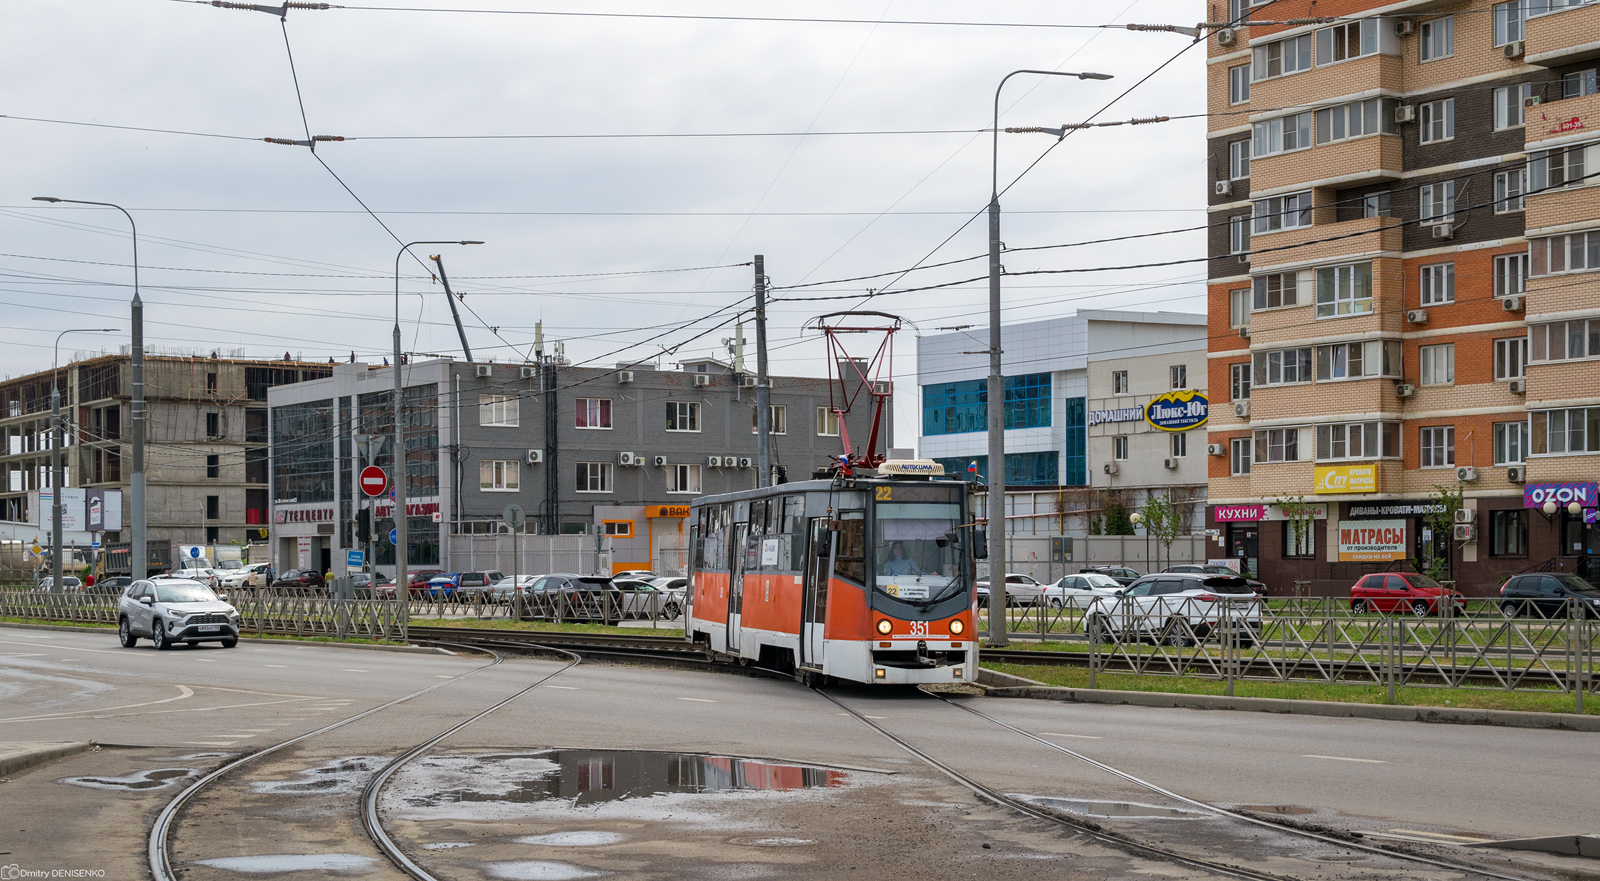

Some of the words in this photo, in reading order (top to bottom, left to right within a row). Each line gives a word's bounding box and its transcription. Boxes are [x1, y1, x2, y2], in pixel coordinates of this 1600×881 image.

[1088, 405, 1144, 426] ДОМАШНИЙ
[1151, 401, 1207, 420] Люкс-Юг
[1350, 468, 1371, 476] КРОВАТИ
[1350, 477, 1373, 485] МАТРАСЫ
[875, 486, 892, 501] 22
[1532, 487, 1587, 503] OZON
[289, 509, 334, 522] ТЕХЦЕНТР
[1218, 508, 1258, 519] КУХНИ
[1341, 528, 1404, 545] МАТРАСЫ
[887, 587, 897, 595] 22
[910, 621, 929, 636] 351
